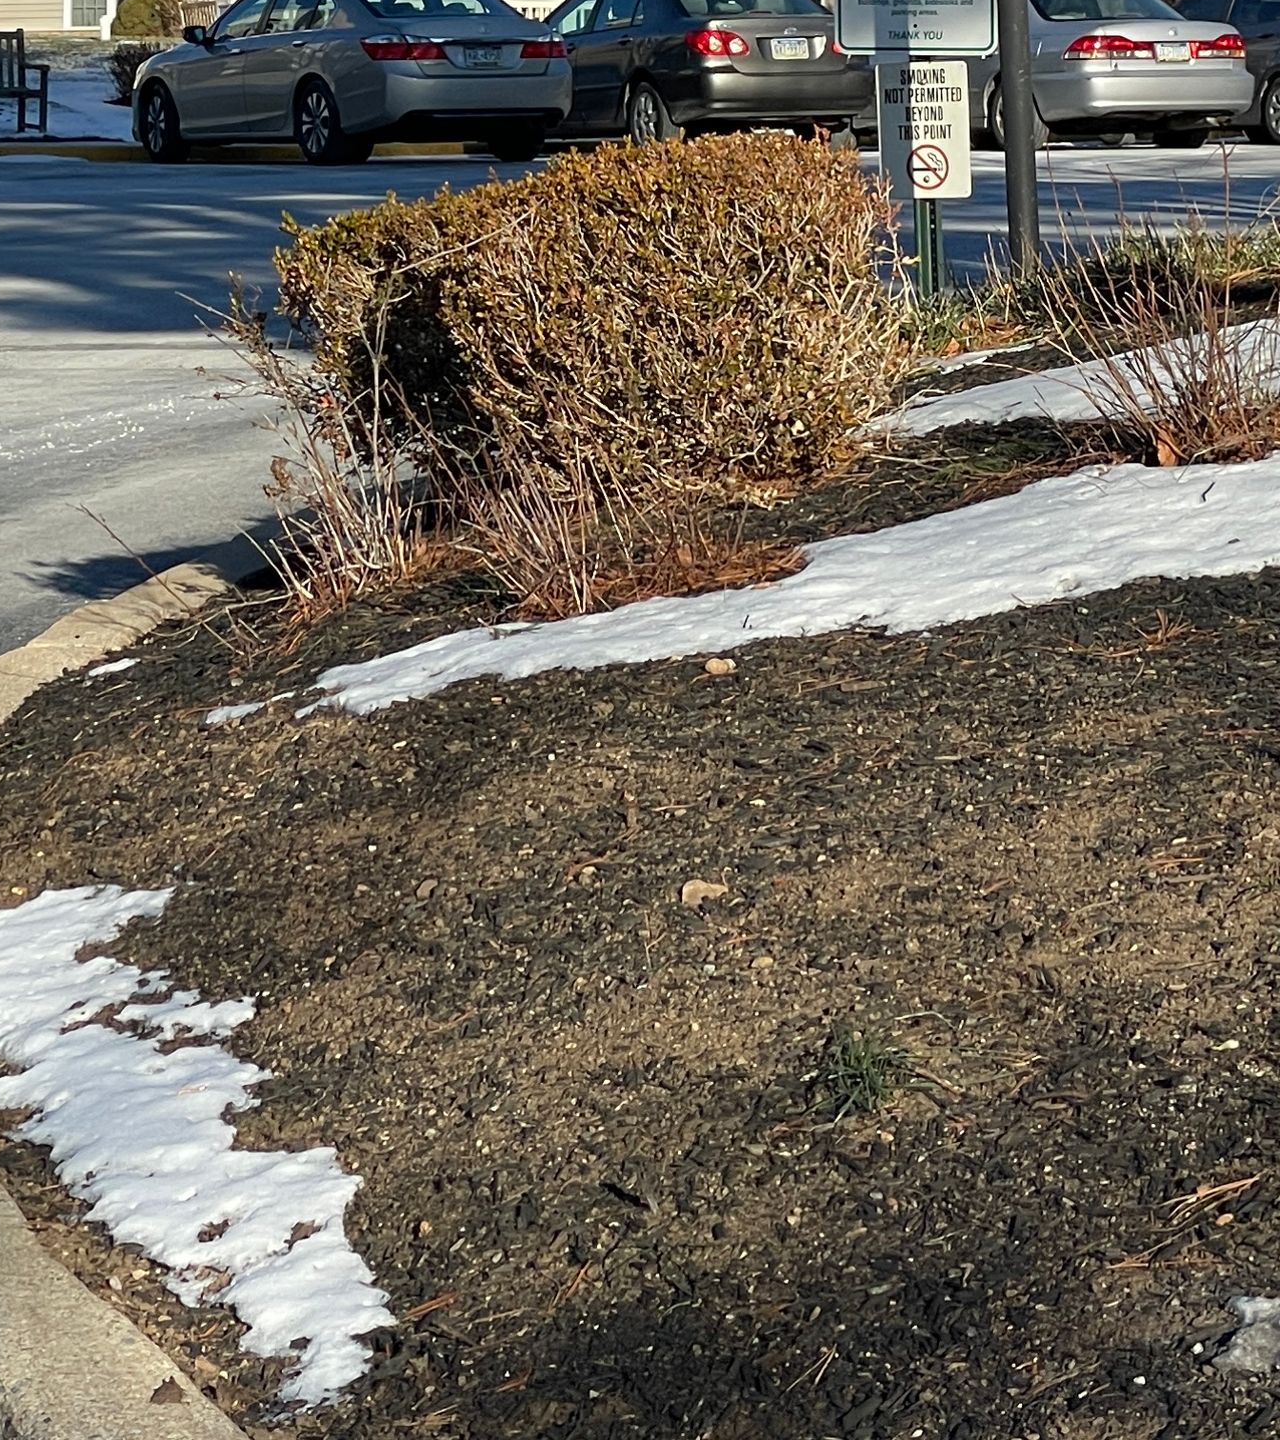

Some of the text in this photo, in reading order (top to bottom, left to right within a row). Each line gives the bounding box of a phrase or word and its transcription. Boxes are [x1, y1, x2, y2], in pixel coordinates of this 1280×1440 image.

[888, 31, 943, 40] THANK YOU
[900, 68, 946, 85] SMOKING
[884, 87, 962, 104] NOT PERMITTED
[905, 106, 944, 122] BEYOND
[898, 124, 952, 140] THIS POINT
